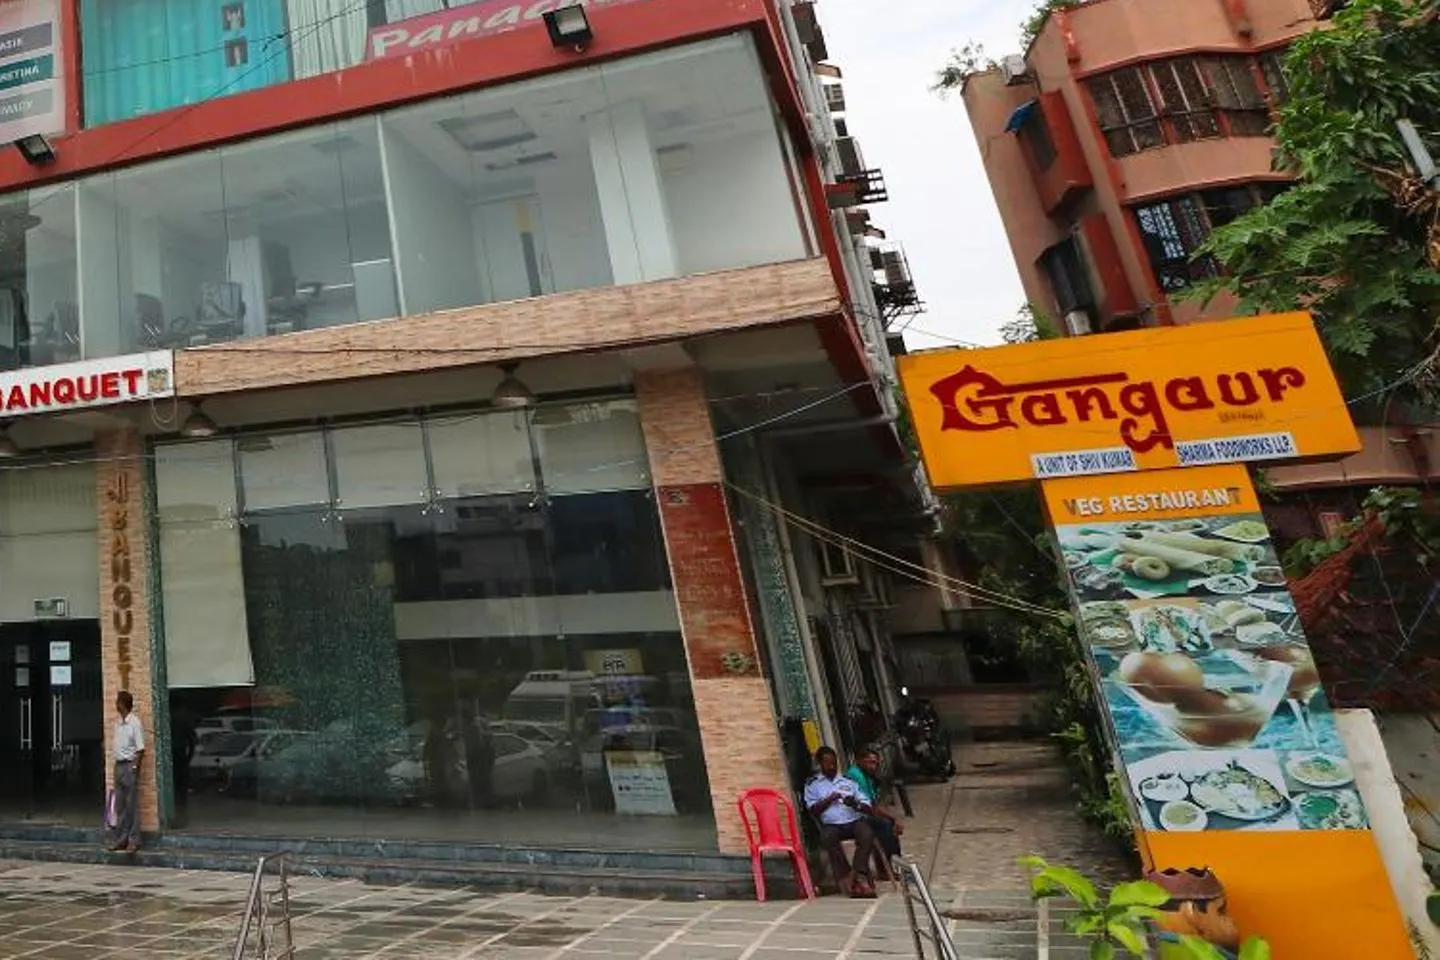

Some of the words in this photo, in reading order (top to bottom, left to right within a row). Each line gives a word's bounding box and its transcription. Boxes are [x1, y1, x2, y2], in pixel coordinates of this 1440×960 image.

[928, 363, 1306, 454] Gangaur
[1036, 457, 1044, 473] A
[1044, 456, 1065, 473] UNIT
[1065, 454, 1078, 472] OF
[1078, 452, 1101, 470] SHIV
[1100, 450, 1134, 469] KUMAR
[1176, 442, 1216, 462] SHARMA
[1215, 437, 1274, 459] FOODWORKS
[111, 508, 134, 690] BANQUET
